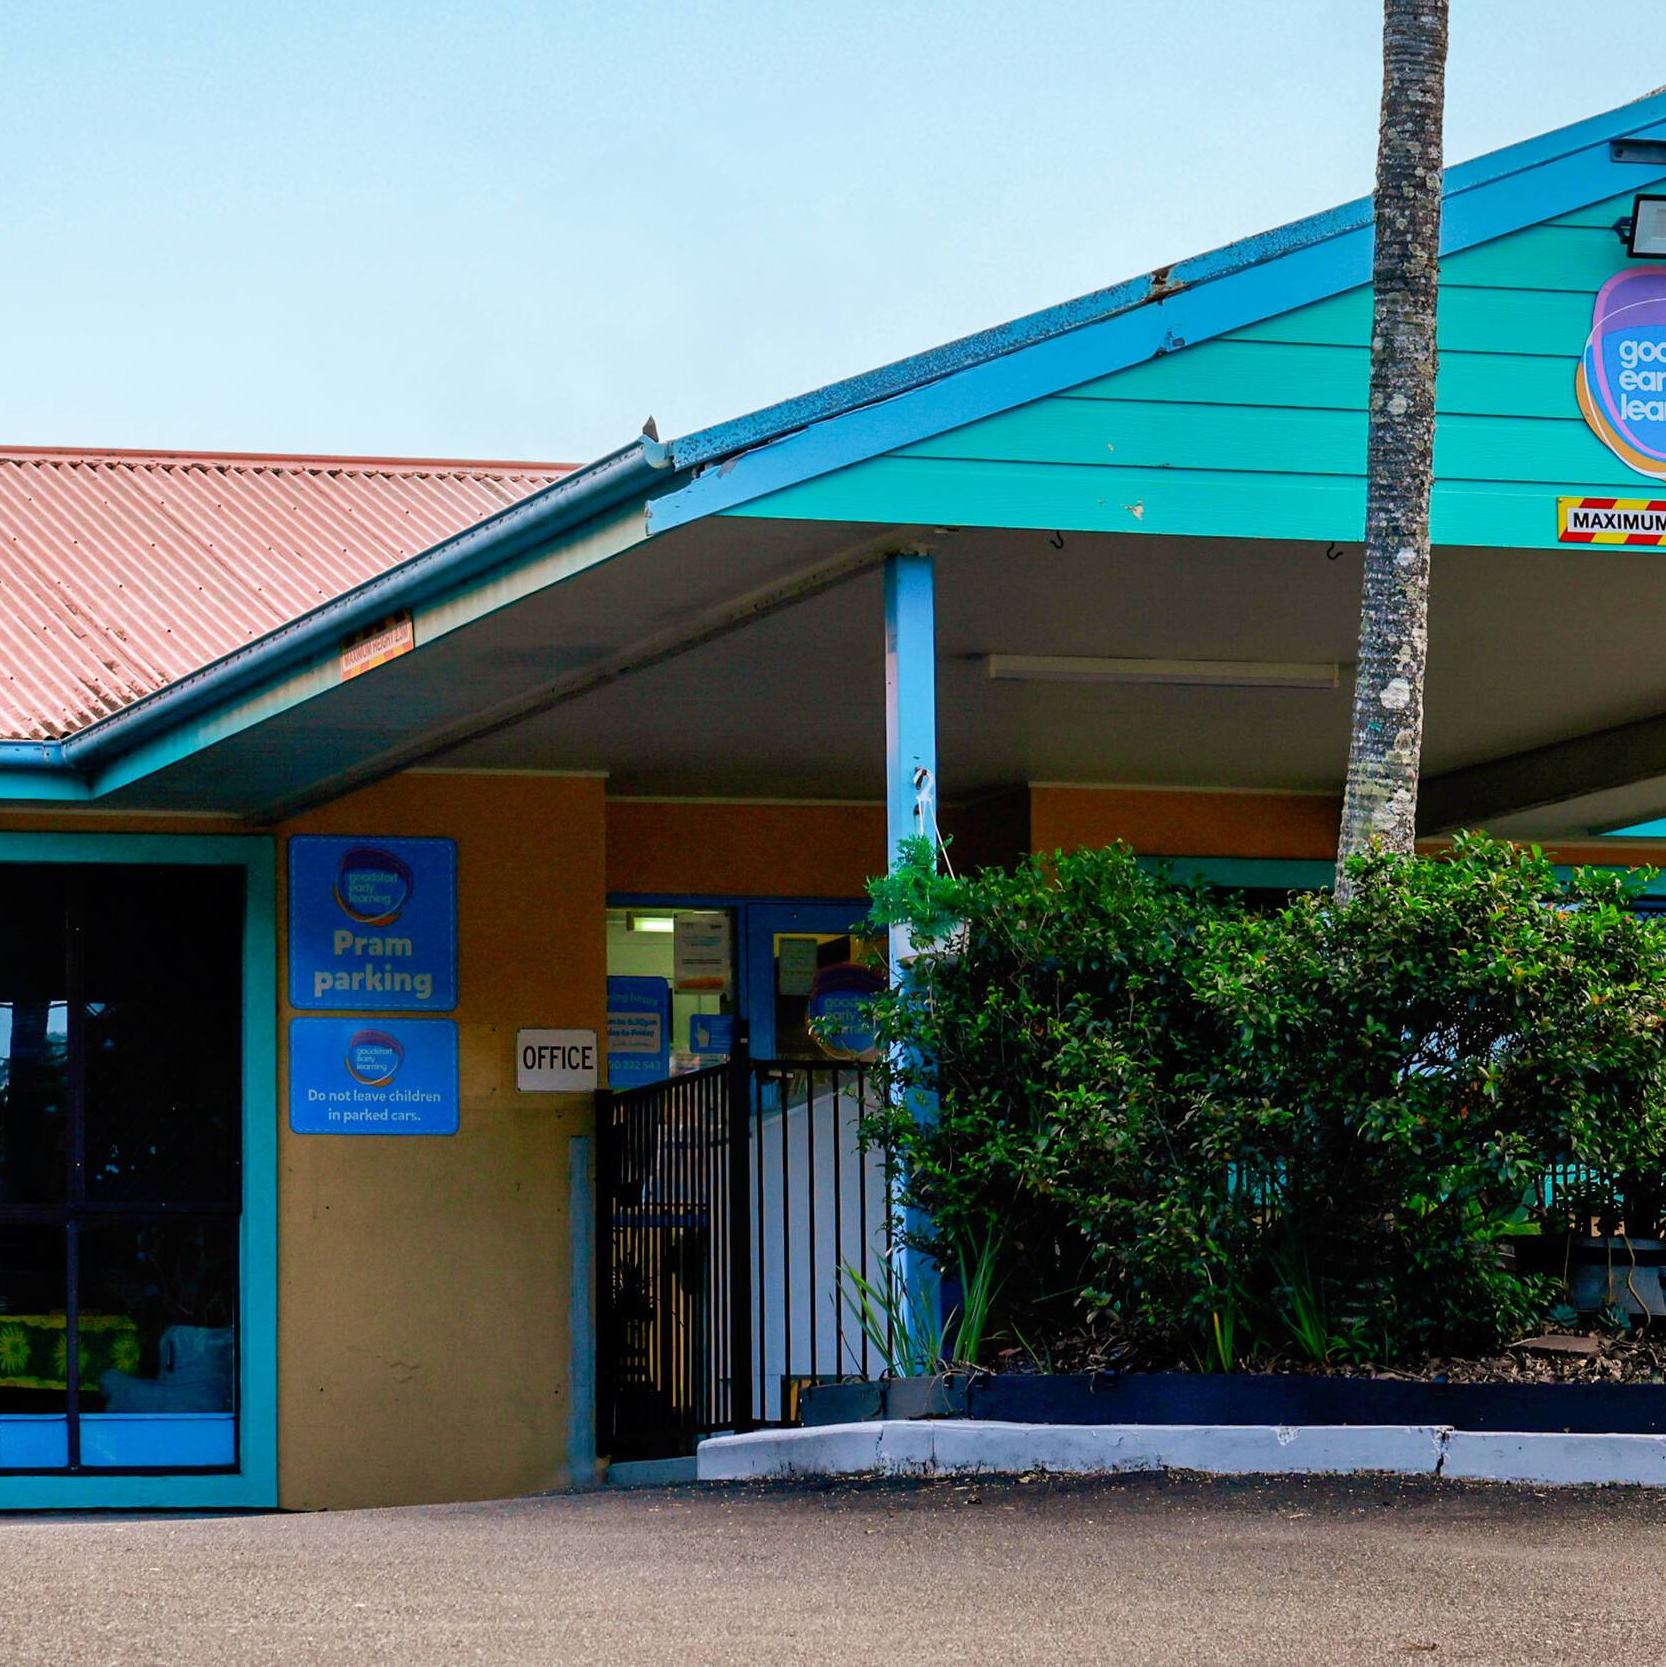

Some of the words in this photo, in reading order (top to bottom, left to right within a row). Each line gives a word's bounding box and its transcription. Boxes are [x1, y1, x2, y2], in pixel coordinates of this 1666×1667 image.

[349, 871, 398, 884] goodstart
[350, 884, 375, 894] early
[349, 893, 391, 905] learning
[334, 929, 412, 956] Pram
[314, 963, 432, 999] parking
[523, 1046, 594, 1070] OFFICE
[308, 1089, 326, 1101] Do
[329, 1090, 351, 1101] not
[353, 1089, 386, 1102] leave
[389, 1089, 441, 1102] children
[328, 1108, 340, 1121] in
[343, 1108, 388, 1124] parked
[391, 1111, 421, 1121] cars.
